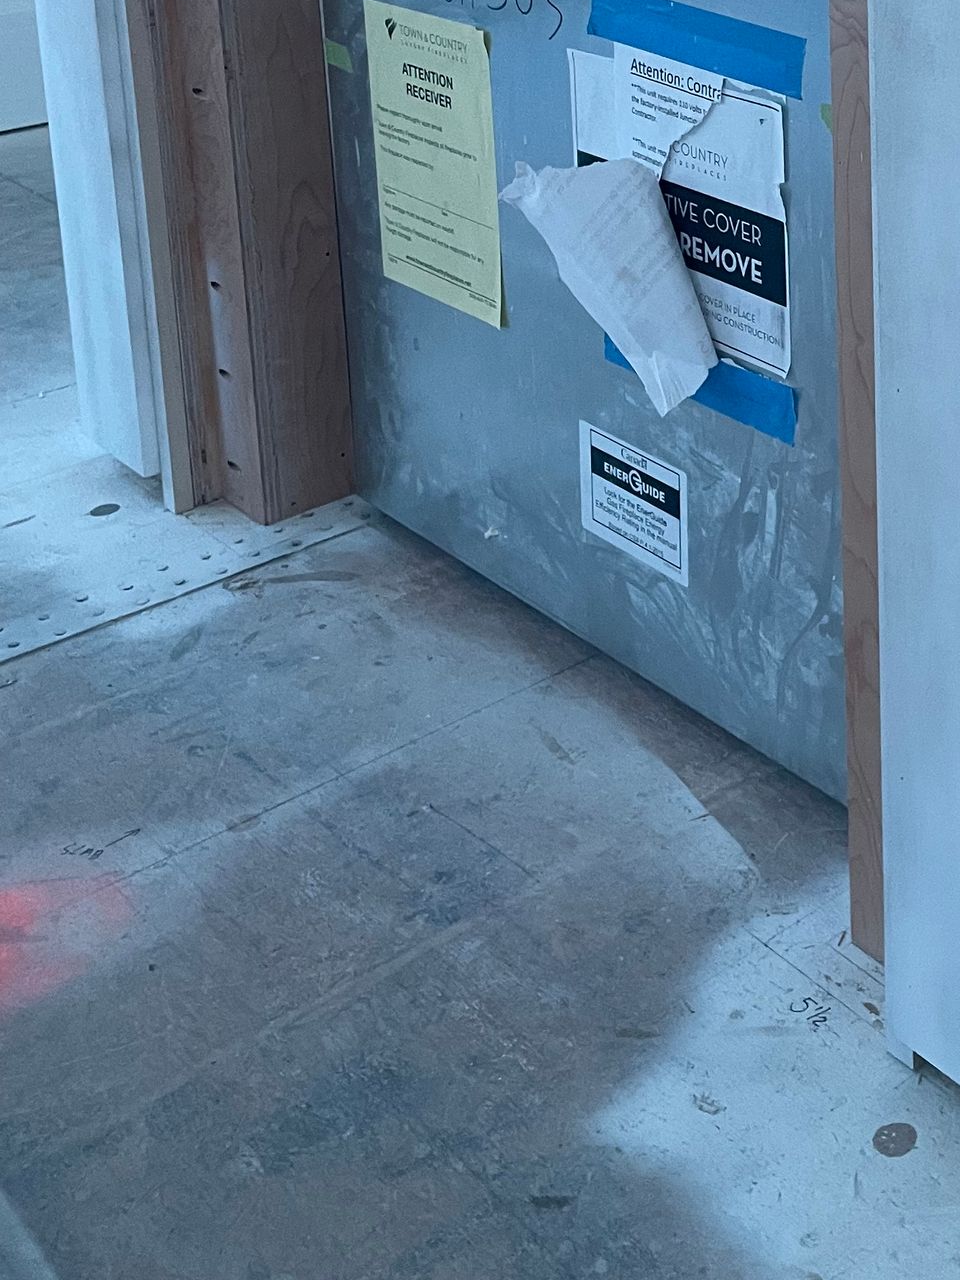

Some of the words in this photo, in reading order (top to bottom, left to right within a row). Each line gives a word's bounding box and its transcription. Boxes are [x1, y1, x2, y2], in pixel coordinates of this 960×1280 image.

[399, 24, 423, 40] TOWN
[424, 32, 429, 43] &
[429, 33, 469, 54] COUNTRY
[402, 62, 454, 90] ATTENTION
[630, 58, 685, 88] Attention:
[406, 83, 453, 110] RECEIVER
[672, 140, 728, 169] COUNTRY
[702, 208, 762, 247] COVER
[679, 231, 763, 285] REMOVE
[724, 304, 732, 314] IN
[733, 307, 756, 323] PLACE
[603, 462, 666, 504] ENERGUIDE
[595, 499, 621, 521] Efficiency
[621, 514, 640, 532] Rating
[646, 528, 656, 540] the
[604, 486, 617, 499] Look
[618, 494, 626, 503] for
[626, 499, 636, 509] the
[636, 504, 668, 527] EnerGuide
[606, 497, 618, 510] Gas
[619, 503, 644, 523] Fireplace
[645, 517, 665, 536] Energy
